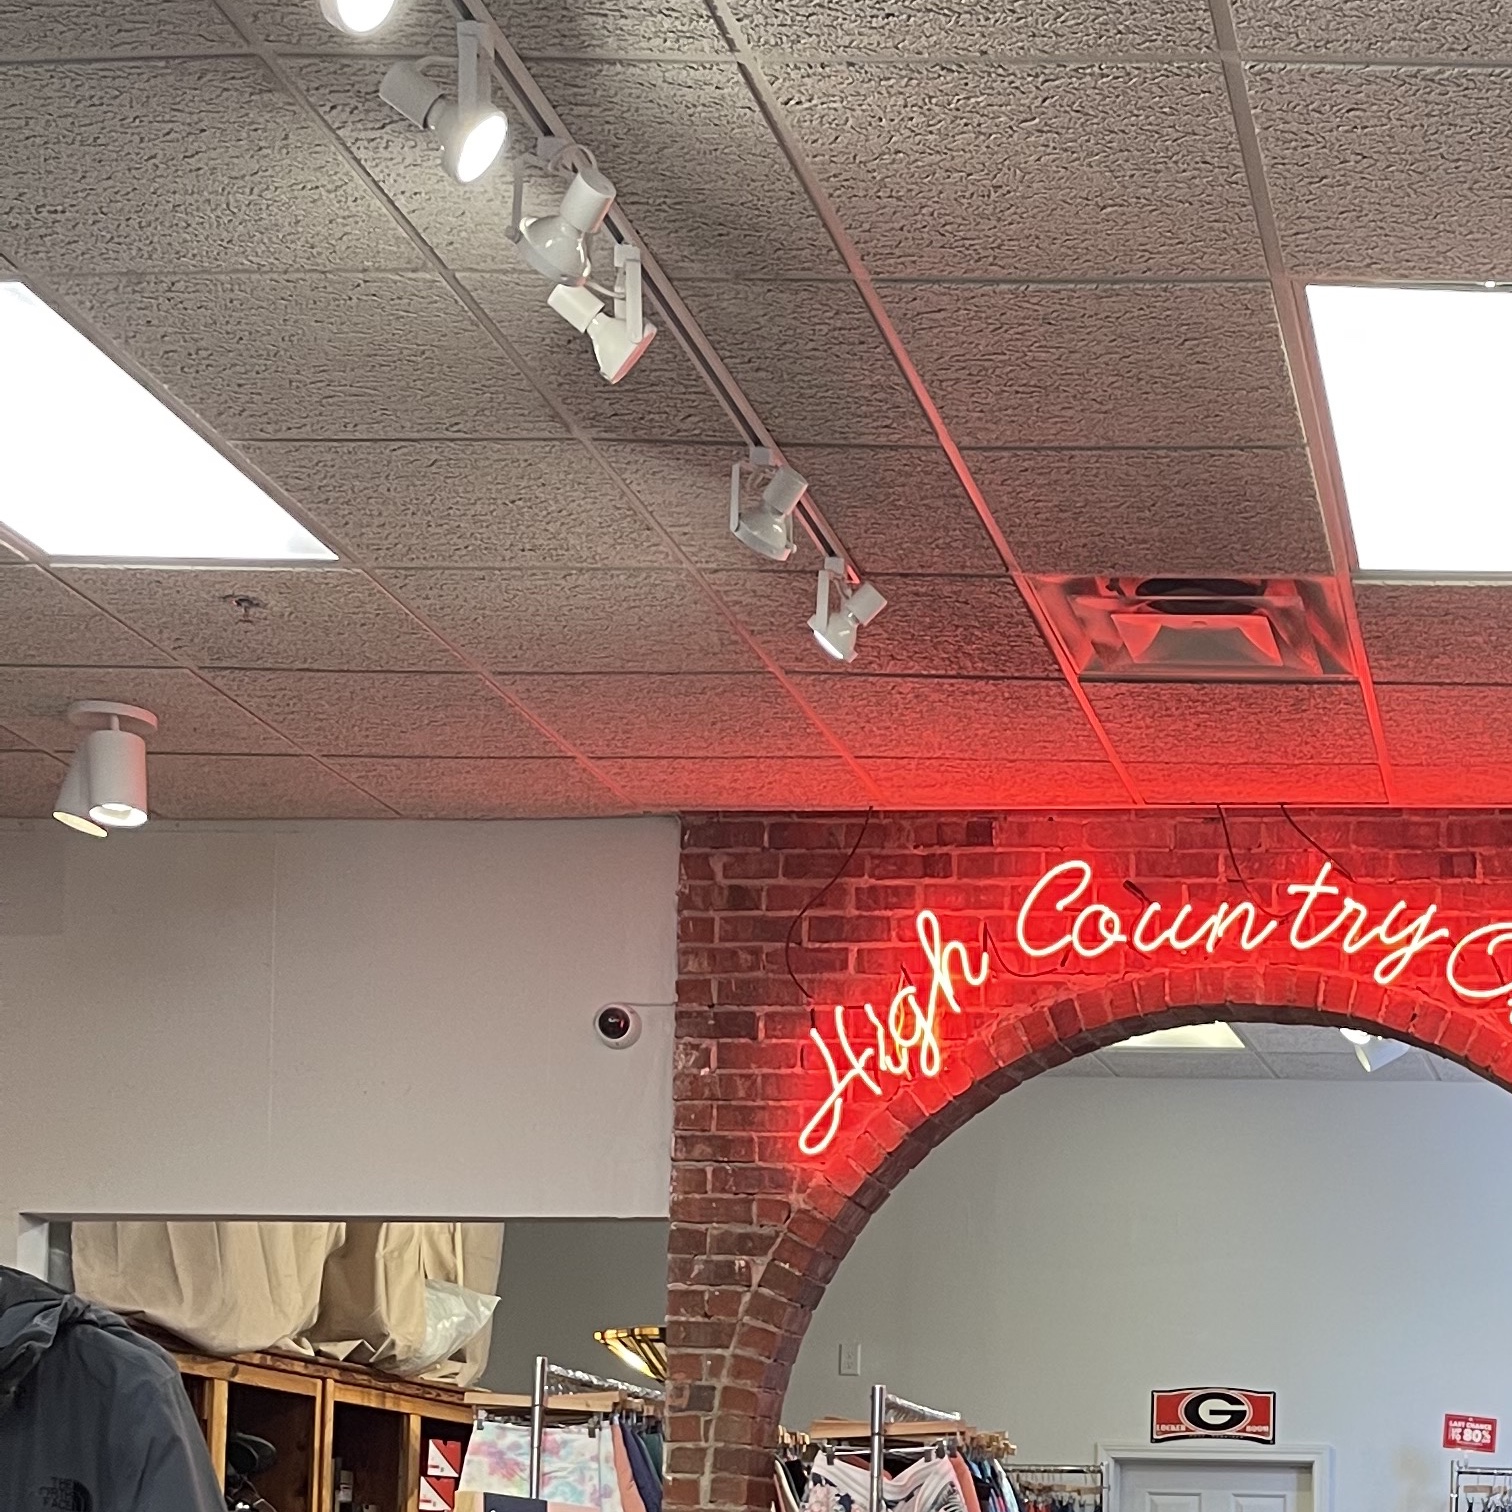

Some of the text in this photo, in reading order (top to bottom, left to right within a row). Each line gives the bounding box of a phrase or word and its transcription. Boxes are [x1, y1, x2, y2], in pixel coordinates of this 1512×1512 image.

[799, 908, 989, 1156] High
[1016, 859, 1450, 985] Country
[1449, 1420, 1492, 1431] LAST CHANCE
[1463, 1429, 1491, 1444] 80%
